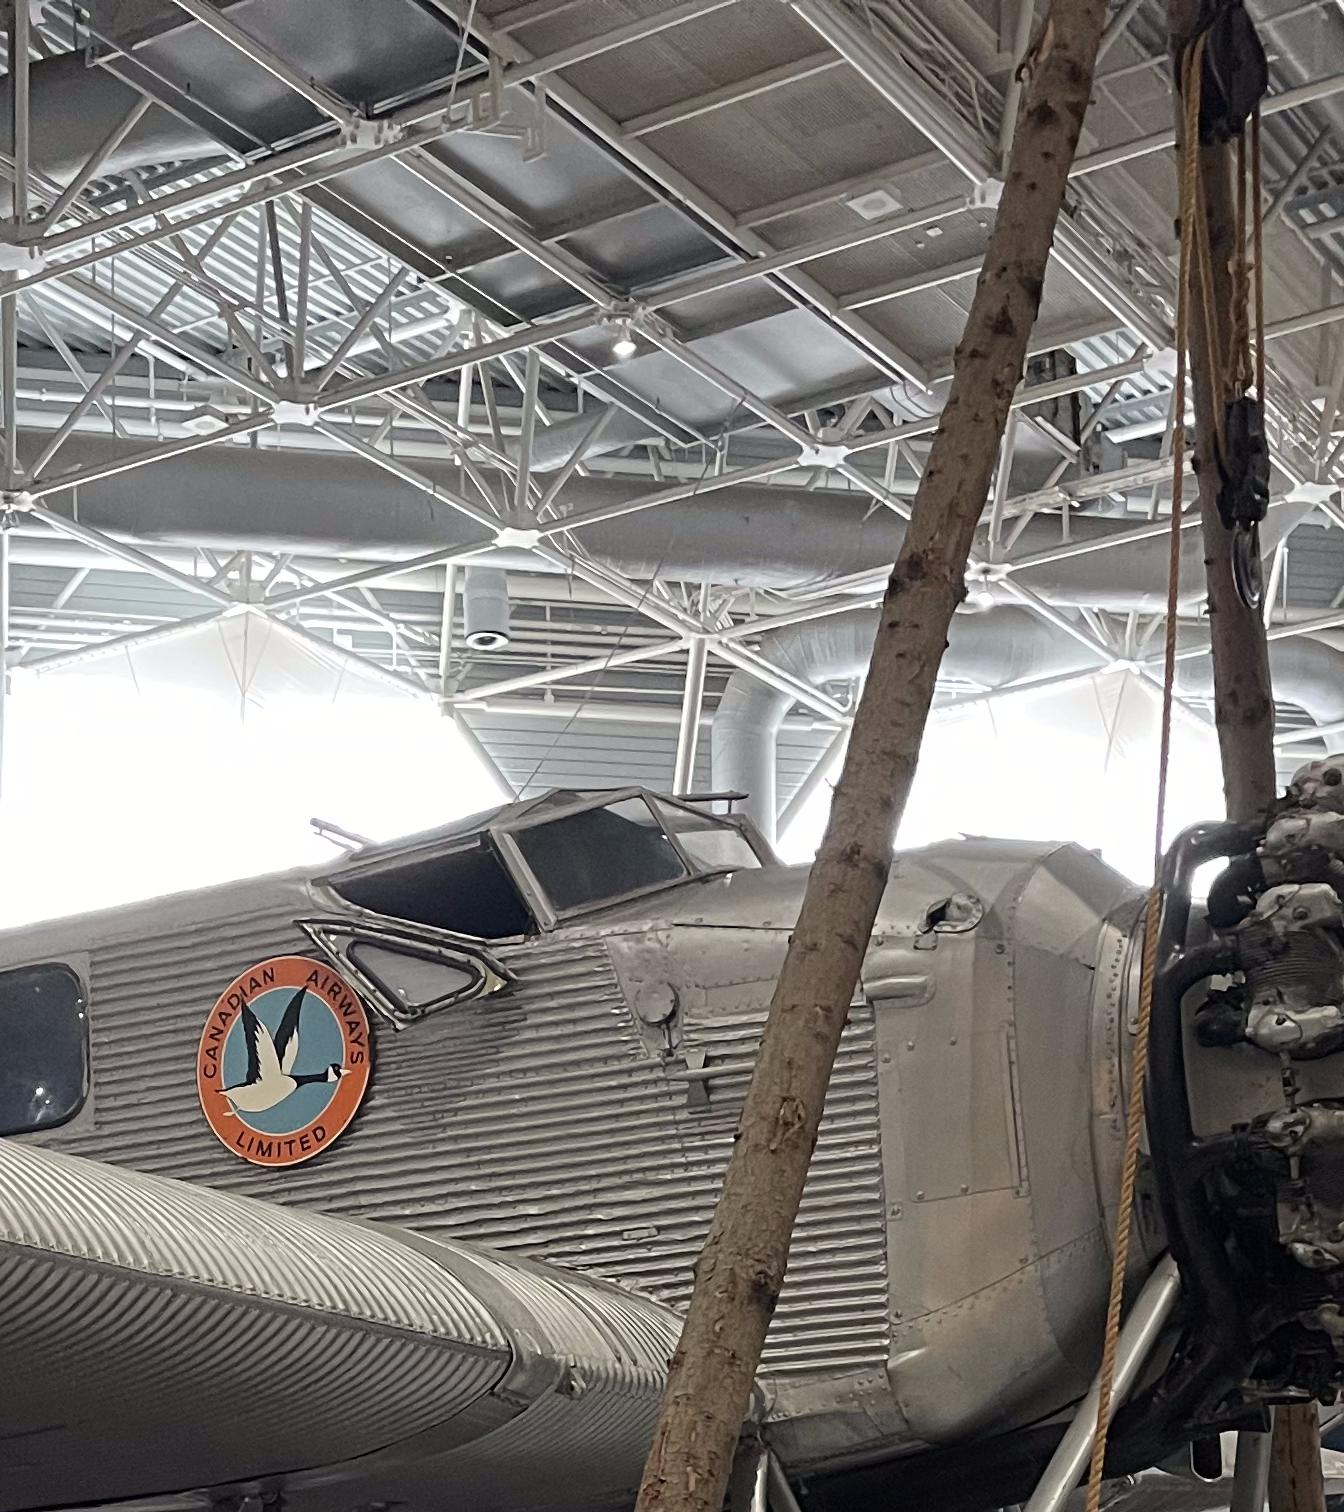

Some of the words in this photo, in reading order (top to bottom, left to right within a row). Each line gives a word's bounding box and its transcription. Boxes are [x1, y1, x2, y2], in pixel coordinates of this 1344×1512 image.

[203, 967, 275, 1079] CANADIAN
[306, 969, 364, 1065] AIRWAYS
[236, 1125, 326, 1158] LIMITED
